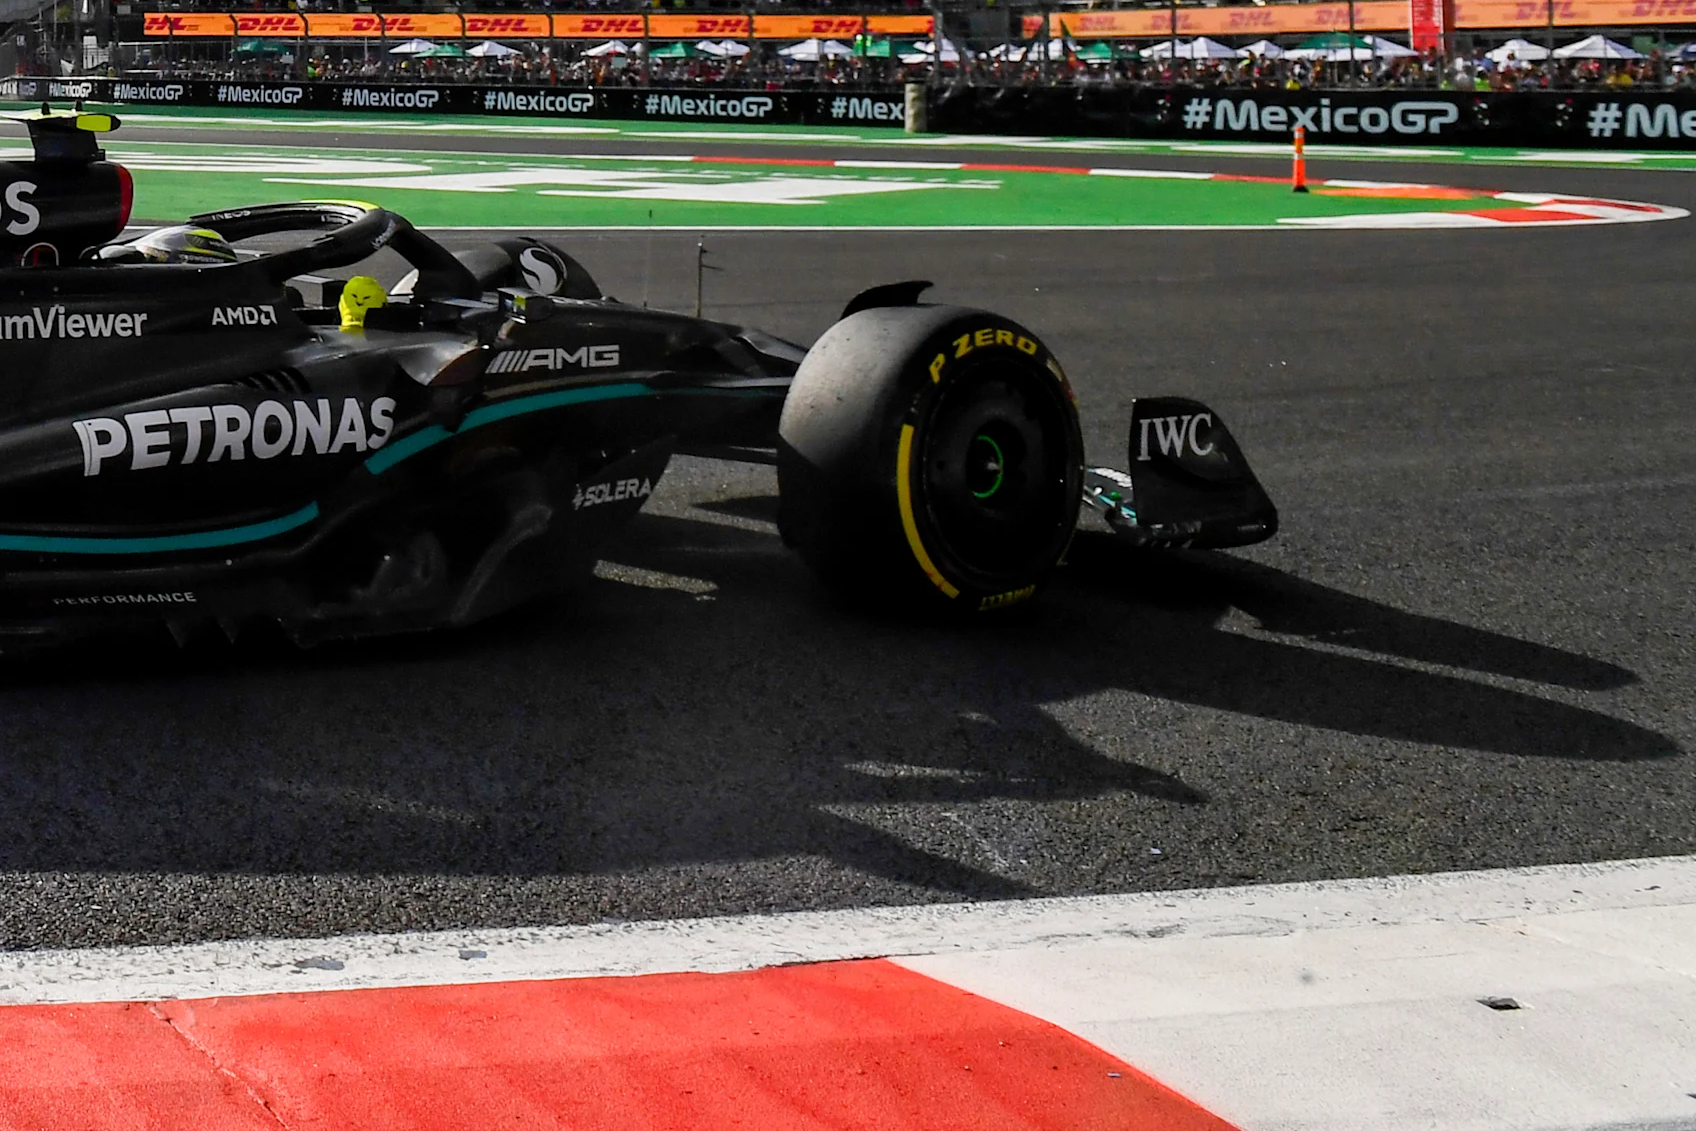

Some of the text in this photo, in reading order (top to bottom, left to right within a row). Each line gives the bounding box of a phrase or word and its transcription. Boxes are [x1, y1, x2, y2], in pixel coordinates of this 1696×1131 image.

[238, 17, 300, 31] DHL
[352, 18, 415, 31] DHL
[467, 18, 528, 32] DHL
[581, 19, 643, 33] DHL
[113, 82, 184, 101] #MexicoGP
[217, 83, 303, 104] #MexicoGP
[342, 85, 439, 108] #MexicoGP
[484, 90, 594, 113] #MexicoGP
[645, 94, 773, 118] #MexicoGP
[1182, 97, 1459, 135] #MexicoGP
[212, 210, 252, 221] INEOS
[212, 306, 259, 326] AMD
[523, 345, 620, 372] AMG
[929, 328, 1039, 384] P ZERO
[73, 396, 397, 477] PETRONAS
[1136, 412, 1214, 462] IWC
[584, 477, 652, 507] SOLERA
[52, 592, 197, 606] PERFORMANCE
